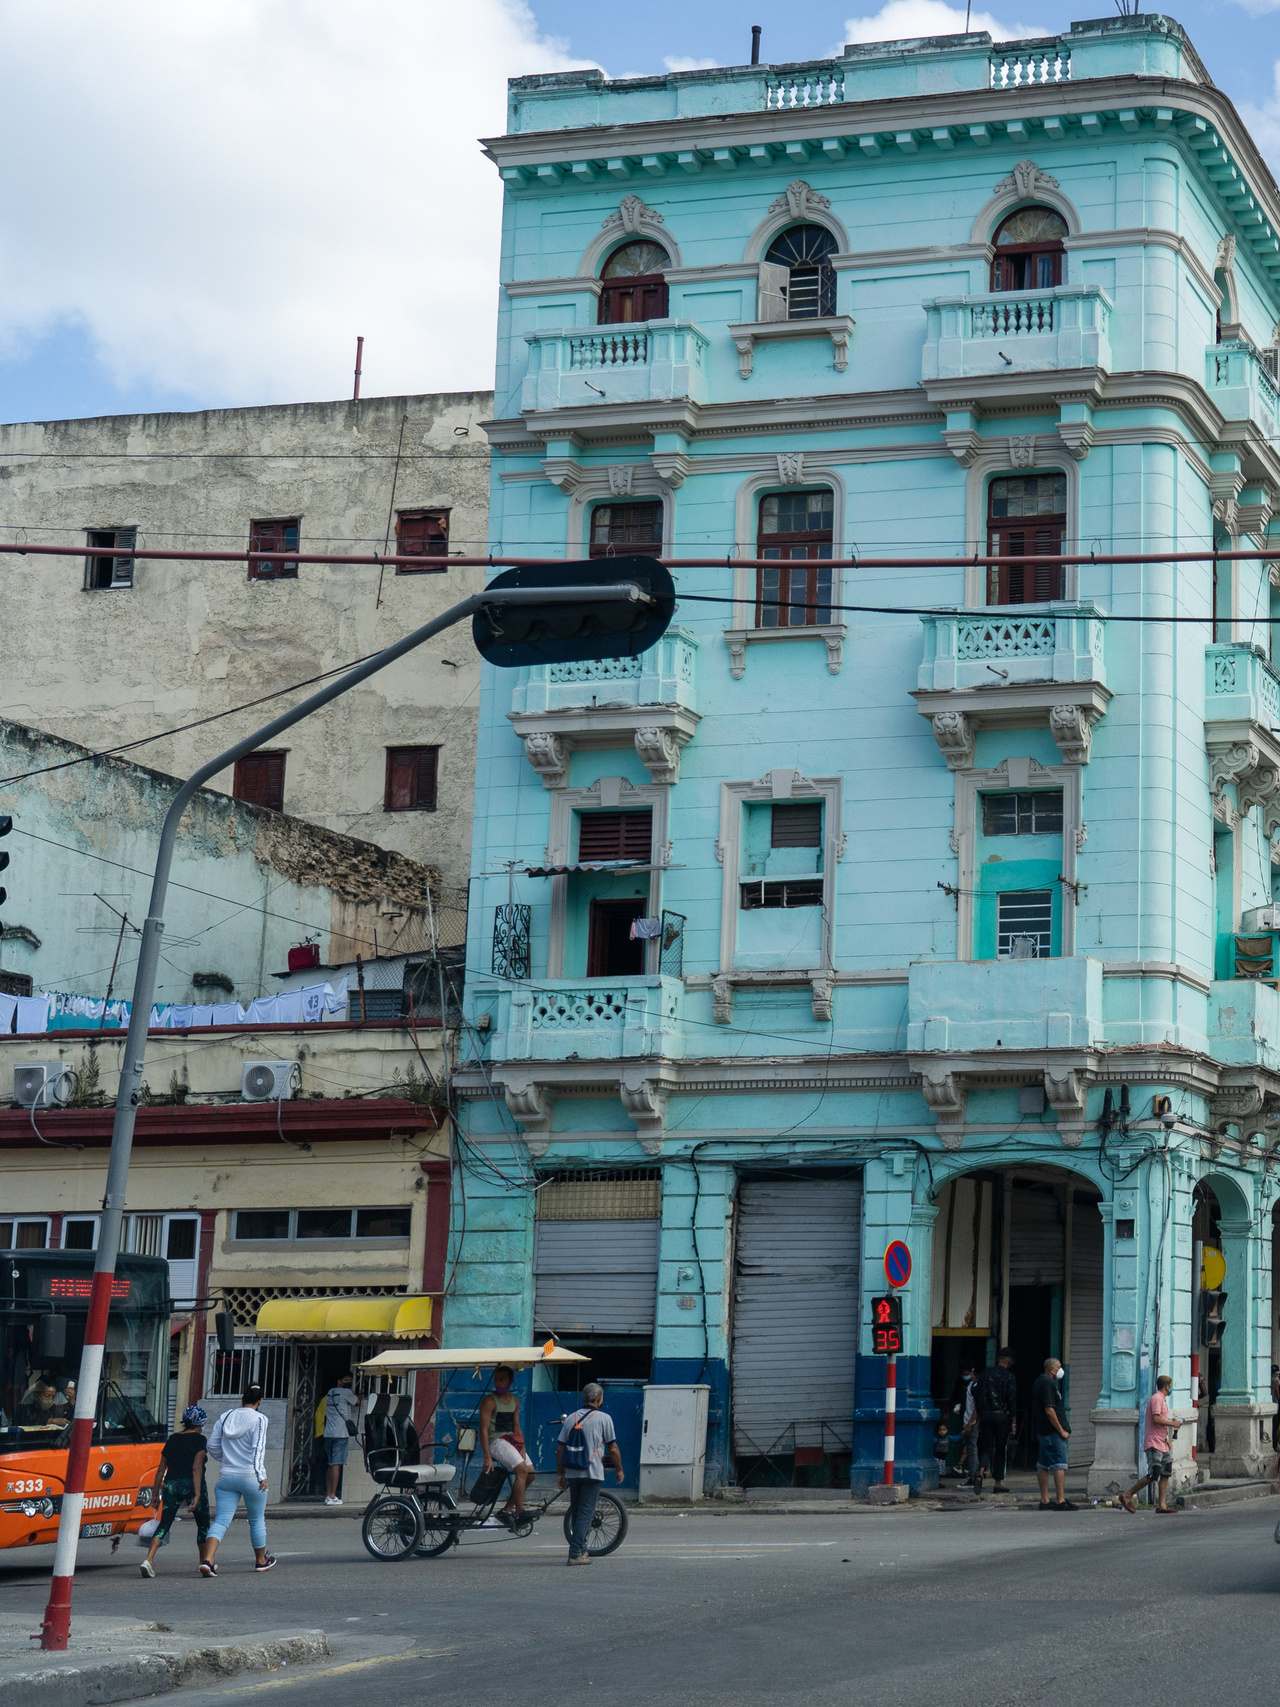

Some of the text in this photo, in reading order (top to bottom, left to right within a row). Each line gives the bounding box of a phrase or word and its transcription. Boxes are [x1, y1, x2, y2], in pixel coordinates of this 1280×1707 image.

[878, 1330, 899, 1349] 35
[15, 1479, 43, 1493] 333
[82, 1494, 132, 1509] RINCIPAL
